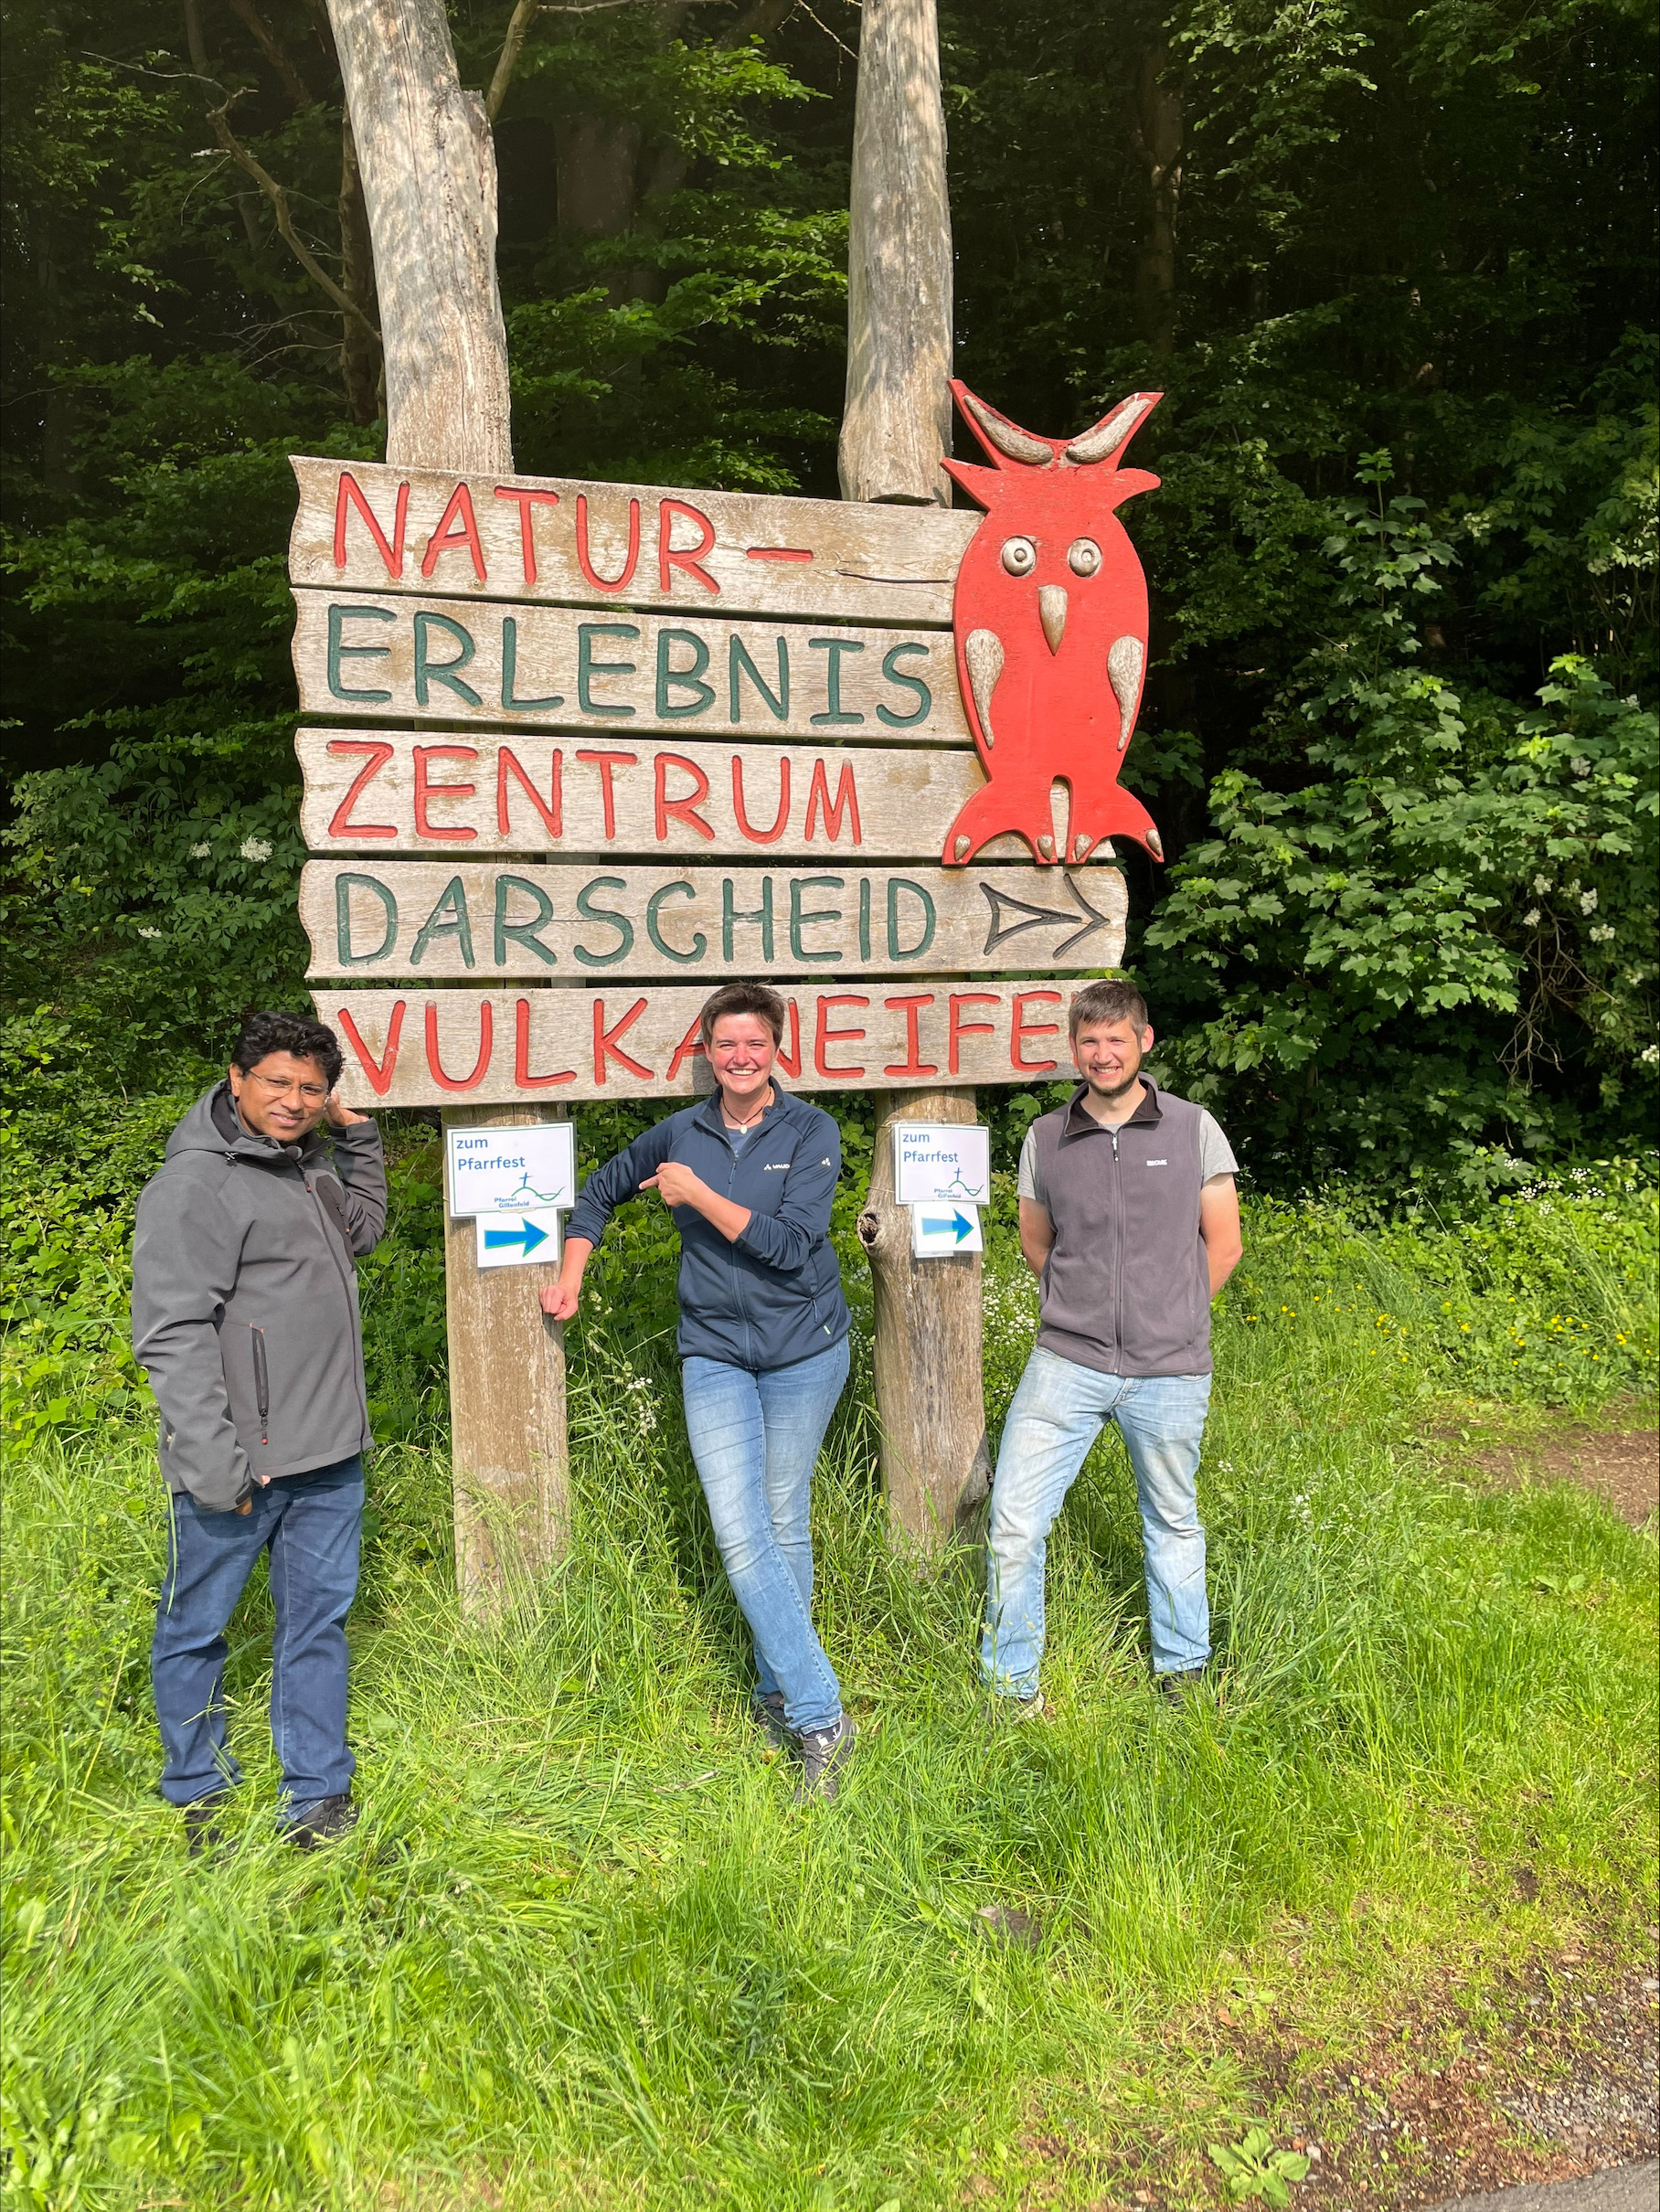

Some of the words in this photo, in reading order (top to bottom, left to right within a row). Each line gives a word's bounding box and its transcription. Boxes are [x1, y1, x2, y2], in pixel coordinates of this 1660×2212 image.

[327, 603, 932, 728] ERLEBNIS
[325, 739, 863, 846] ZENTRUM
[335, 871, 936, 970] DARSCHEID
[336, 990, 1080, 1097] VULKEIFE
[456, 1138, 489, 1150] zum
[458, 1156, 527, 1171] Pfarrfest
[902, 1133, 931, 1143] zum
[903, 1151, 959, 1163] Pfarrfest
